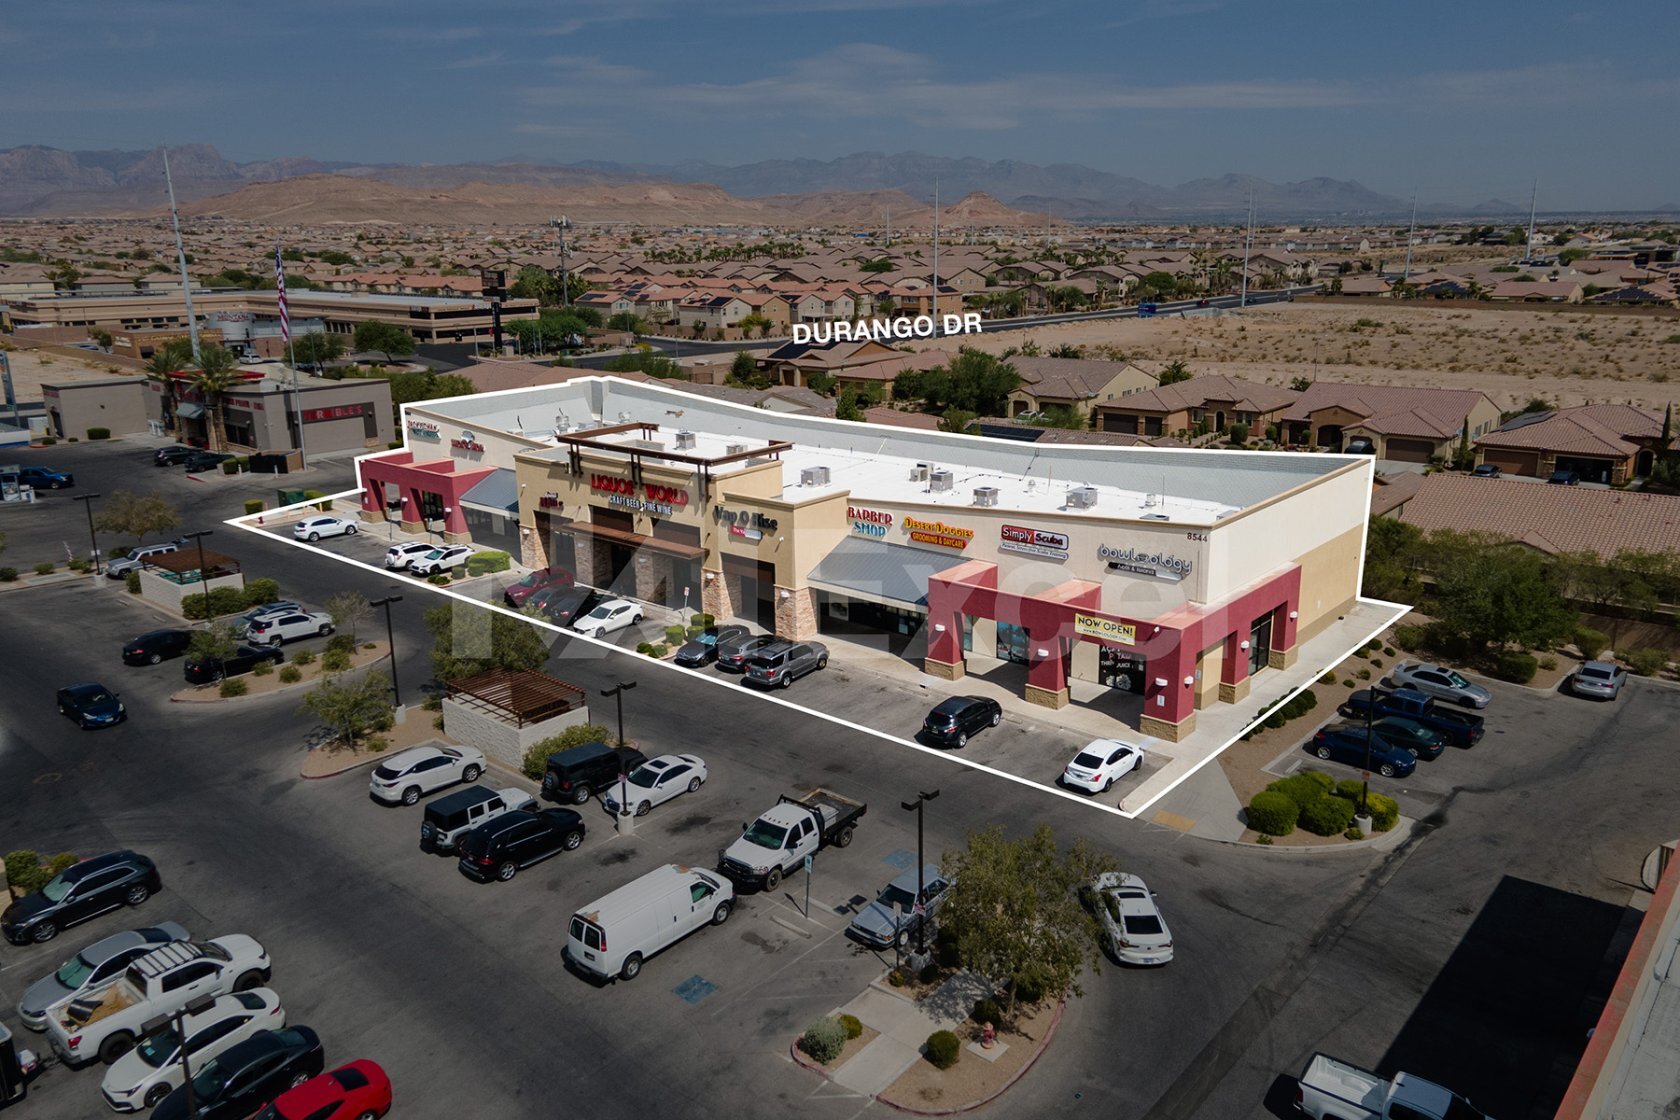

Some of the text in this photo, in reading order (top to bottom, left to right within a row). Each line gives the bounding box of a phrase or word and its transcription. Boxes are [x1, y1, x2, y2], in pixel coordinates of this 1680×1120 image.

[591, 473, 689, 506] LIQUOR WORLD
[609, 495, 626, 506] CRAFT
[657, 504, 672, 515] WINE
[847, 505, 893, 526] BARBER
[854, 521, 887, 538] SHOP
[904, 516, 974, 538] DESERT DOGGIES
[1002, 527, 1063, 546] Simply Scuba
[912, 532, 938, 544] GROOMING
[943, 537, 964, 549] DAYCARE
[1187, 532, 1208, 543] 8544
[1078, 617, 1133, 636] NOW OPEN!
